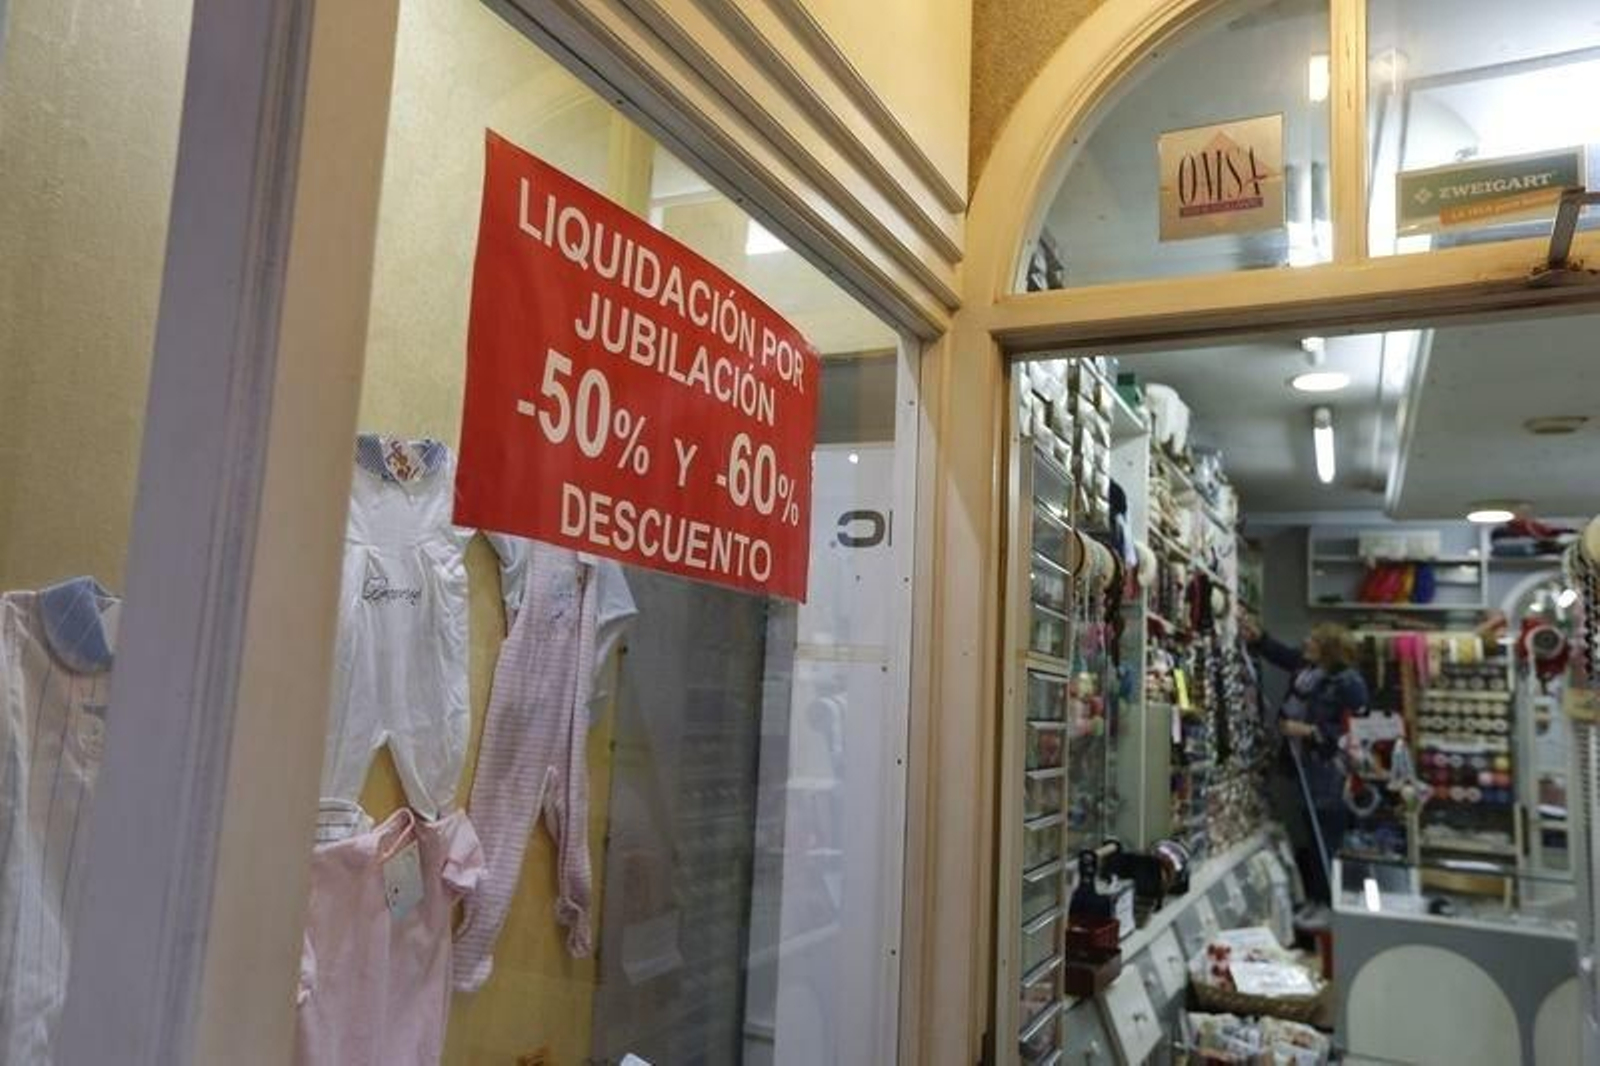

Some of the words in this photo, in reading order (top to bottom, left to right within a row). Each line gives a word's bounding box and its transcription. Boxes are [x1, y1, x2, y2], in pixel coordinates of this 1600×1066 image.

[1438, 172, 1552, 199] ZWEIGART
[518, 177, 756, 358] LIQUIDACIÓN
[762, 327, 805, 394] POR
[574, 292, 776, 426] JUBILACIÓN
[516, 348, 651, 476] -50%
[673, 437, 699, 488] Y
[715, 432, 799, 527] -60%
[560, 481, 773, 583] DESCUENTO
